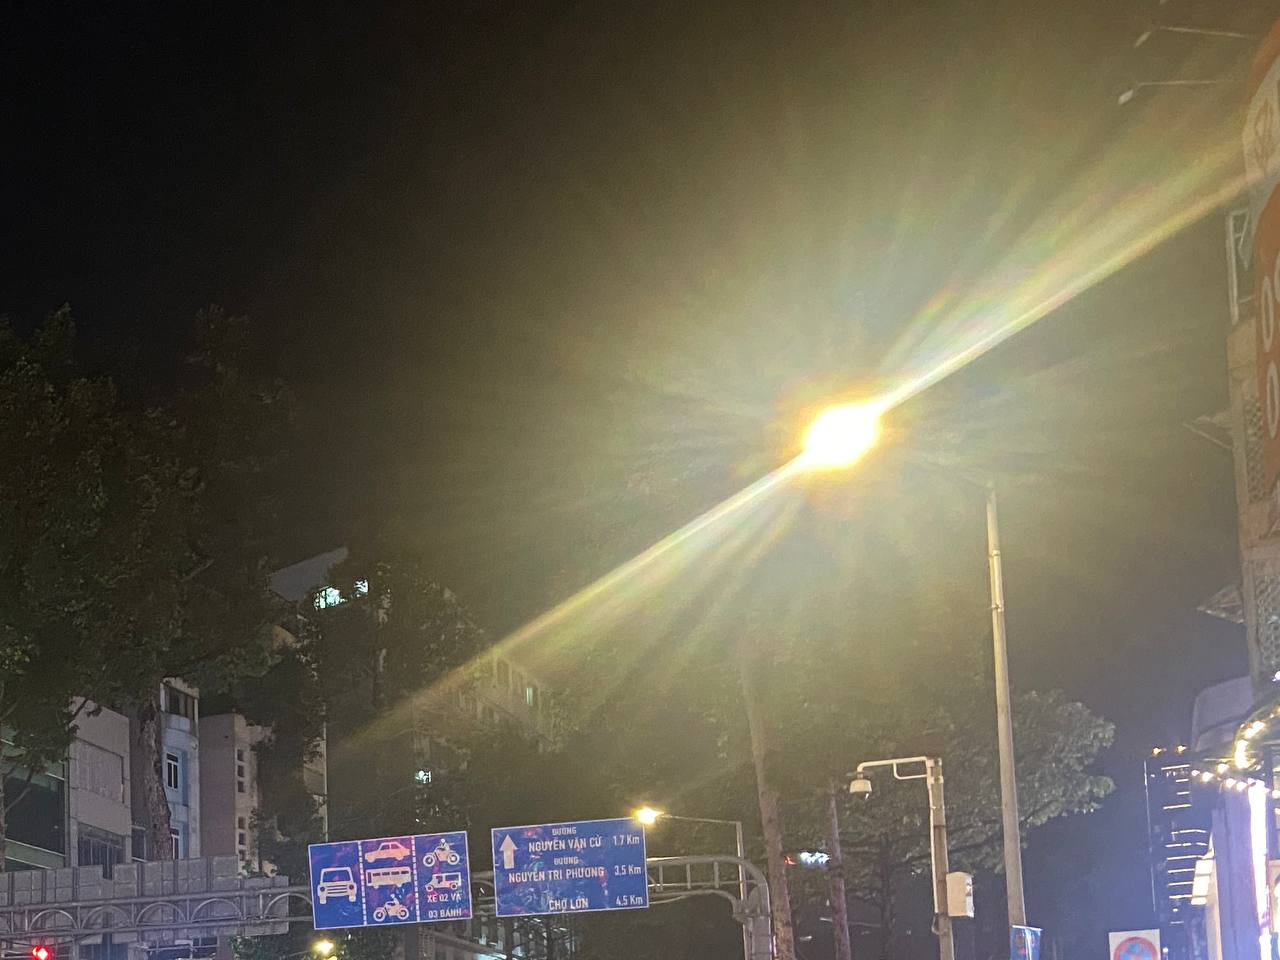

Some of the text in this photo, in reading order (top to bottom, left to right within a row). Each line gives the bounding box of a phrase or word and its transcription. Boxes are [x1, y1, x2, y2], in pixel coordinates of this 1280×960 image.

[626, 835, 640, 846] Km
[628, 864, 642, 875] Km
[427, 895, 437, 903] XE
[630, 895, 644, 906] Km
